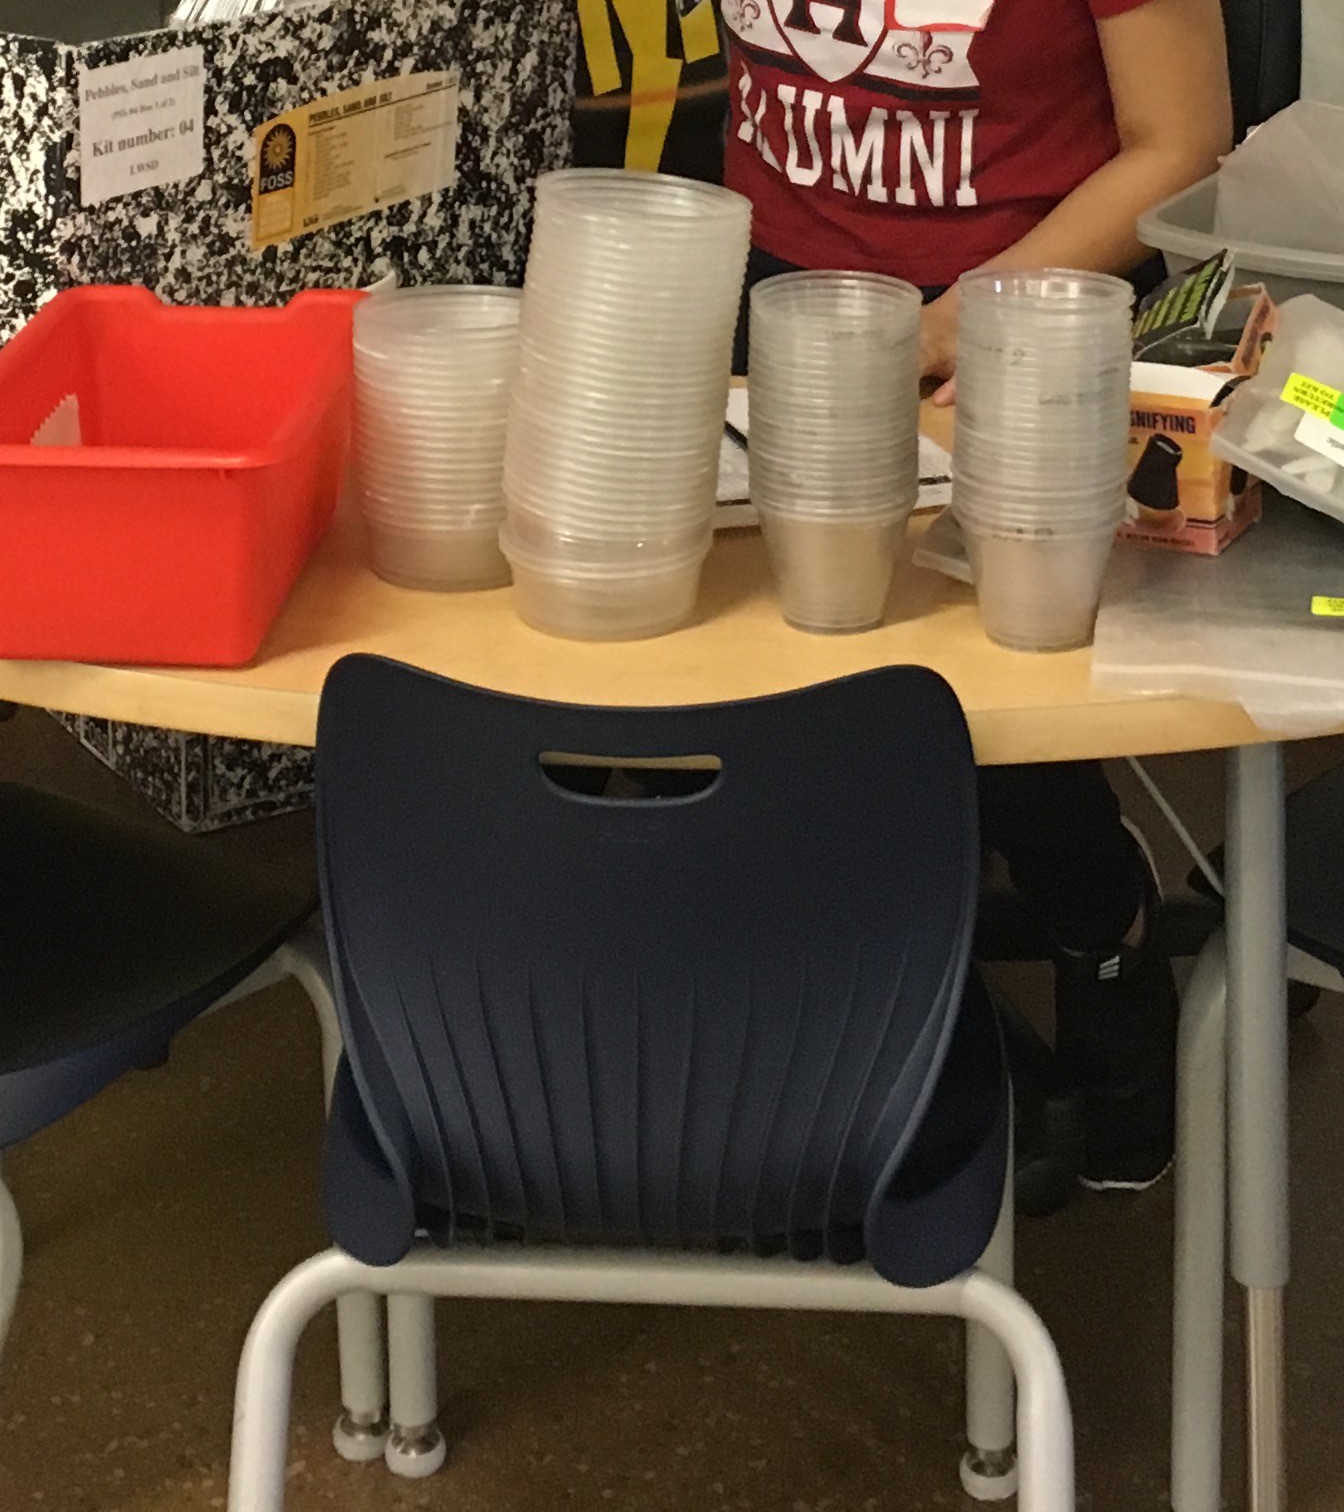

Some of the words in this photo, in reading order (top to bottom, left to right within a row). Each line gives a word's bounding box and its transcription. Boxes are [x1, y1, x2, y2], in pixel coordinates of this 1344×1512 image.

[92, 141, 113, 157] Kit
[117, 128, 175, 152] number:
[179, 118, 195, 136] 04
[260, 171, 293, 191] FOSS
